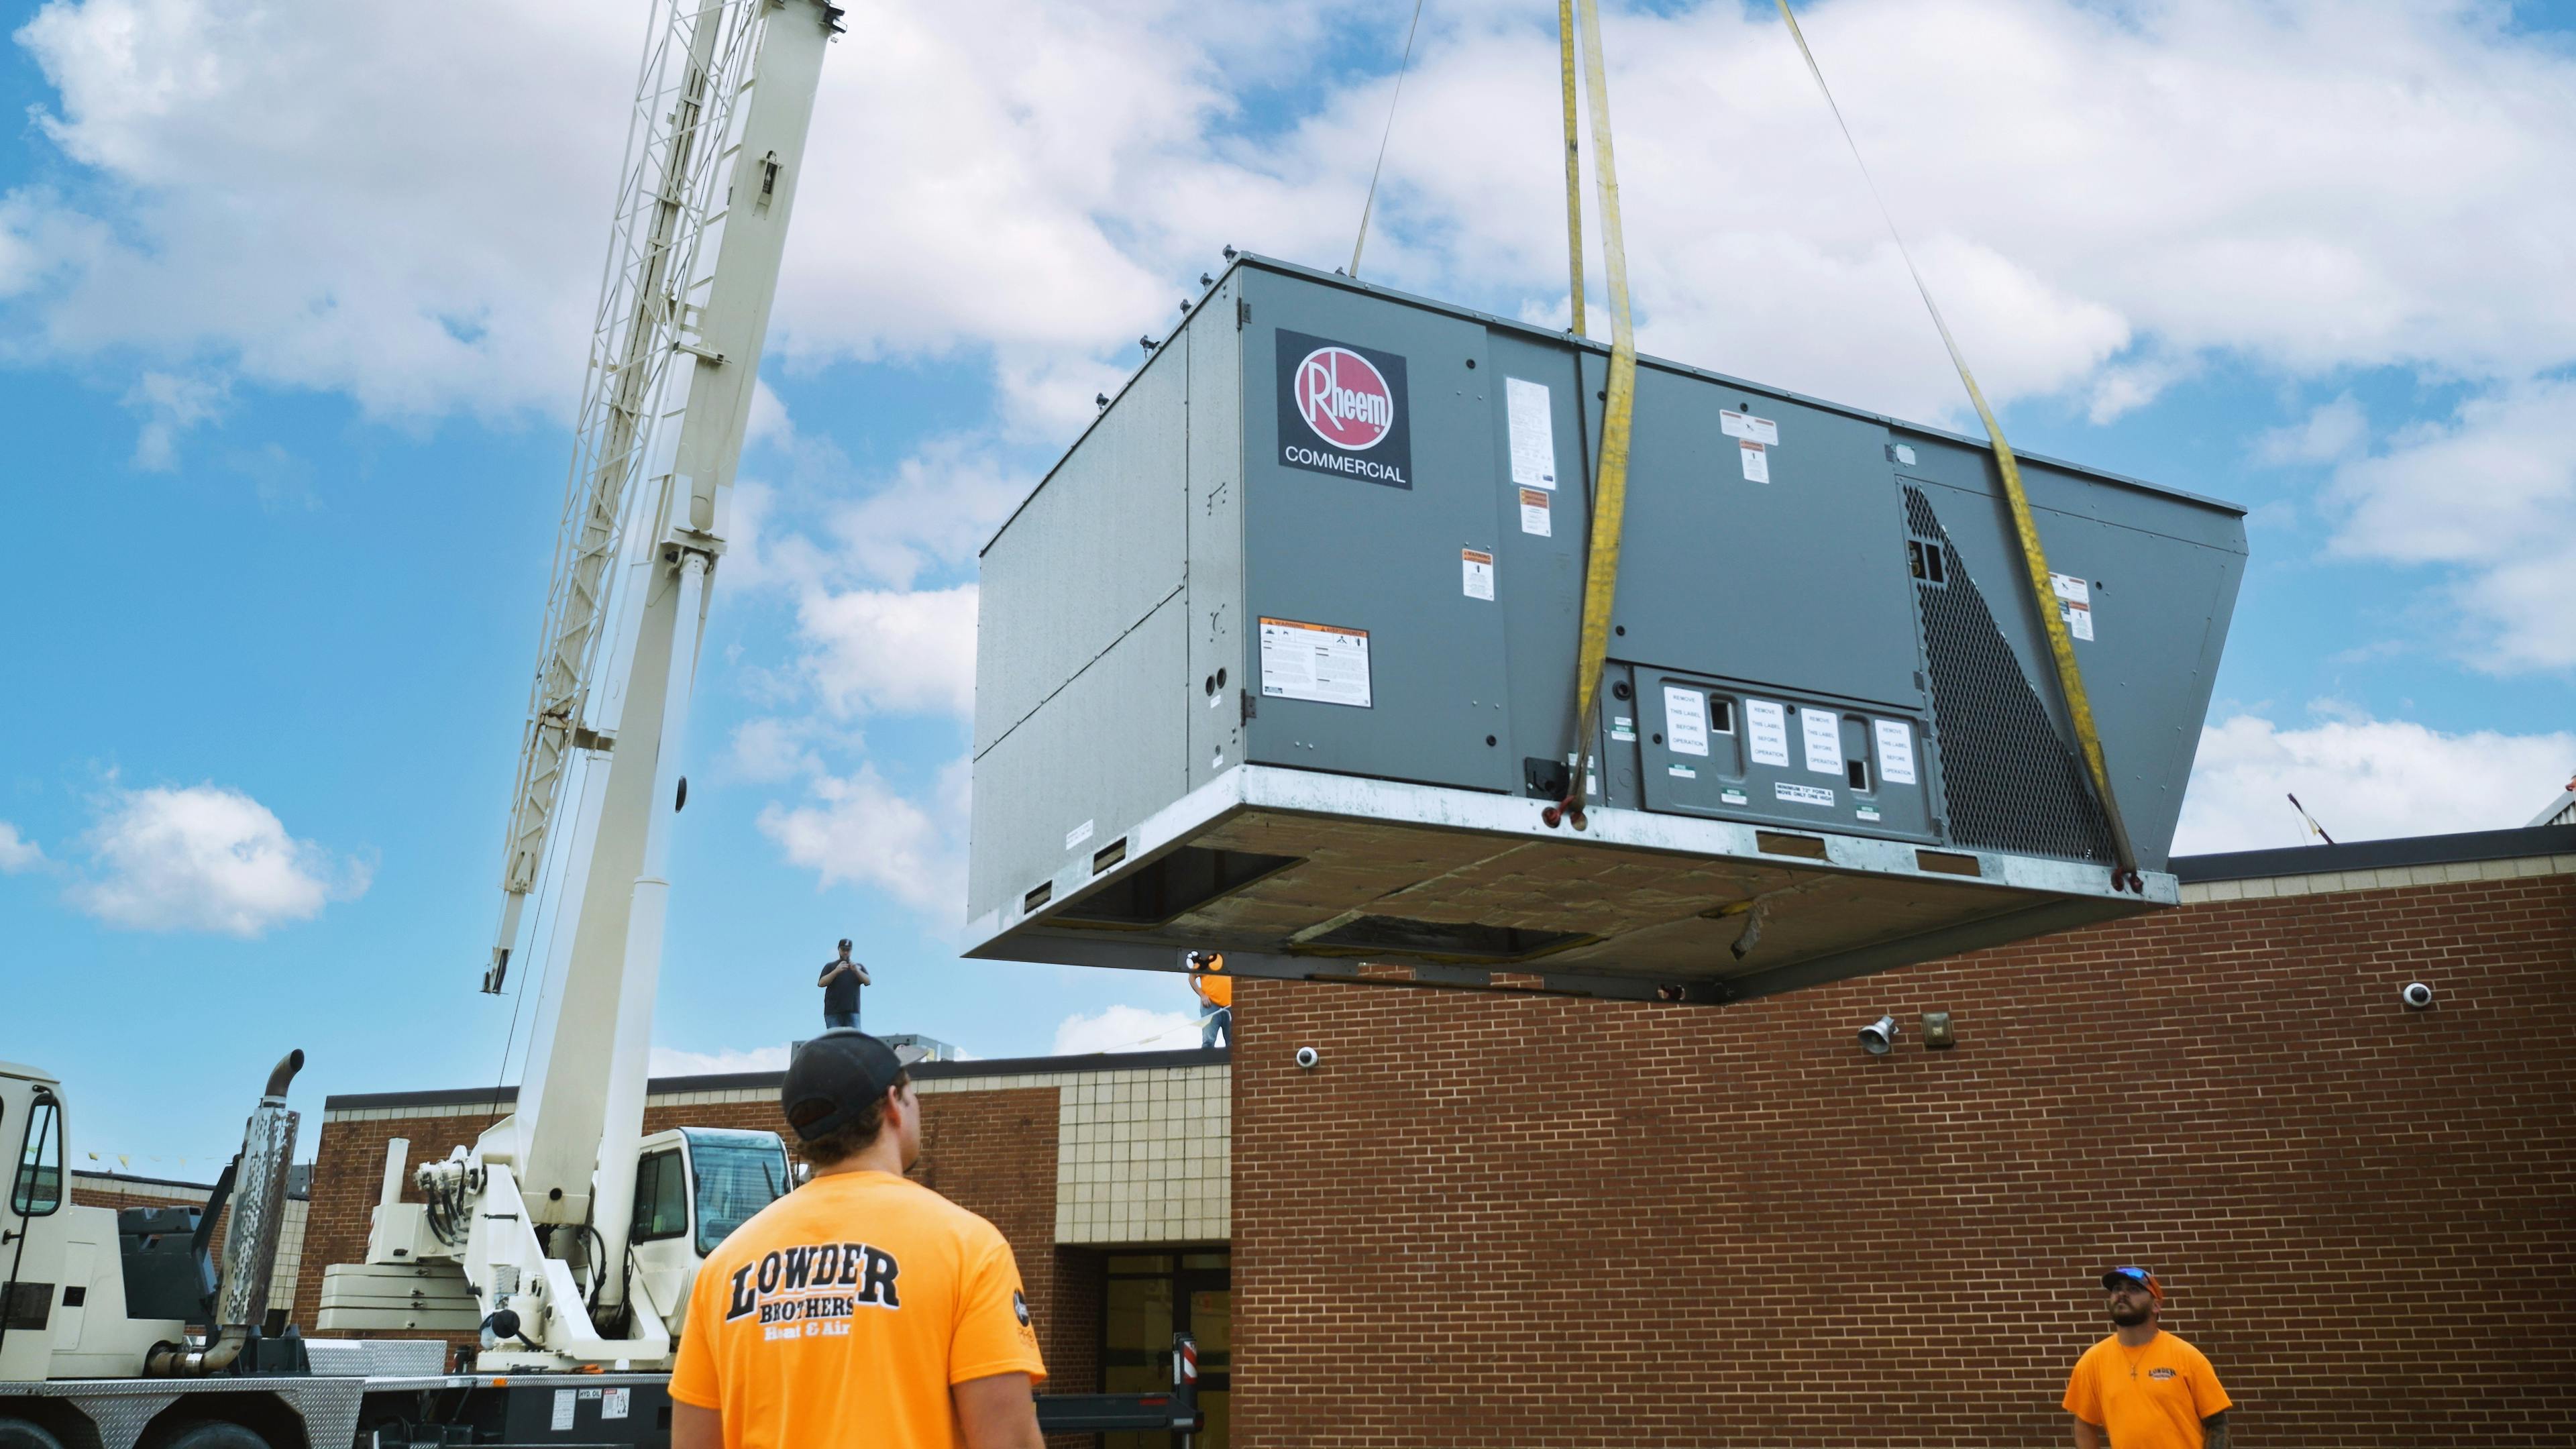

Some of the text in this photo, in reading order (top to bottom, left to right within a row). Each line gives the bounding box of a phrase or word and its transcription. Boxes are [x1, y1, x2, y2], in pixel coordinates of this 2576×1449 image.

[1308, 352, 1386, 431] Rheem
[1285, 445, 1407, 484] COMMERCIAL
[1275, 621, 1305, 629] WARNING
[1684, 710, 1701, 718] LABEL
[1758, 735, 1778, 743] BEFORE
[1819, 731, 1835, 739] LABEL
[1672, 737, 1704, 747] OPERATION
[1813, 743, 1832, 751] BEFORE
[1754, 748, 1784, 757] OPERATION
[1809, 757, 1838, 766] OPERATION
[1884, 767, 1911, 775] OPERATION
[725, 1242, 900, 1322] LOWDER
[759, 1295, 854, 1324] BROTHERS
[763, 1320, 851, 1341] Hat & Air
